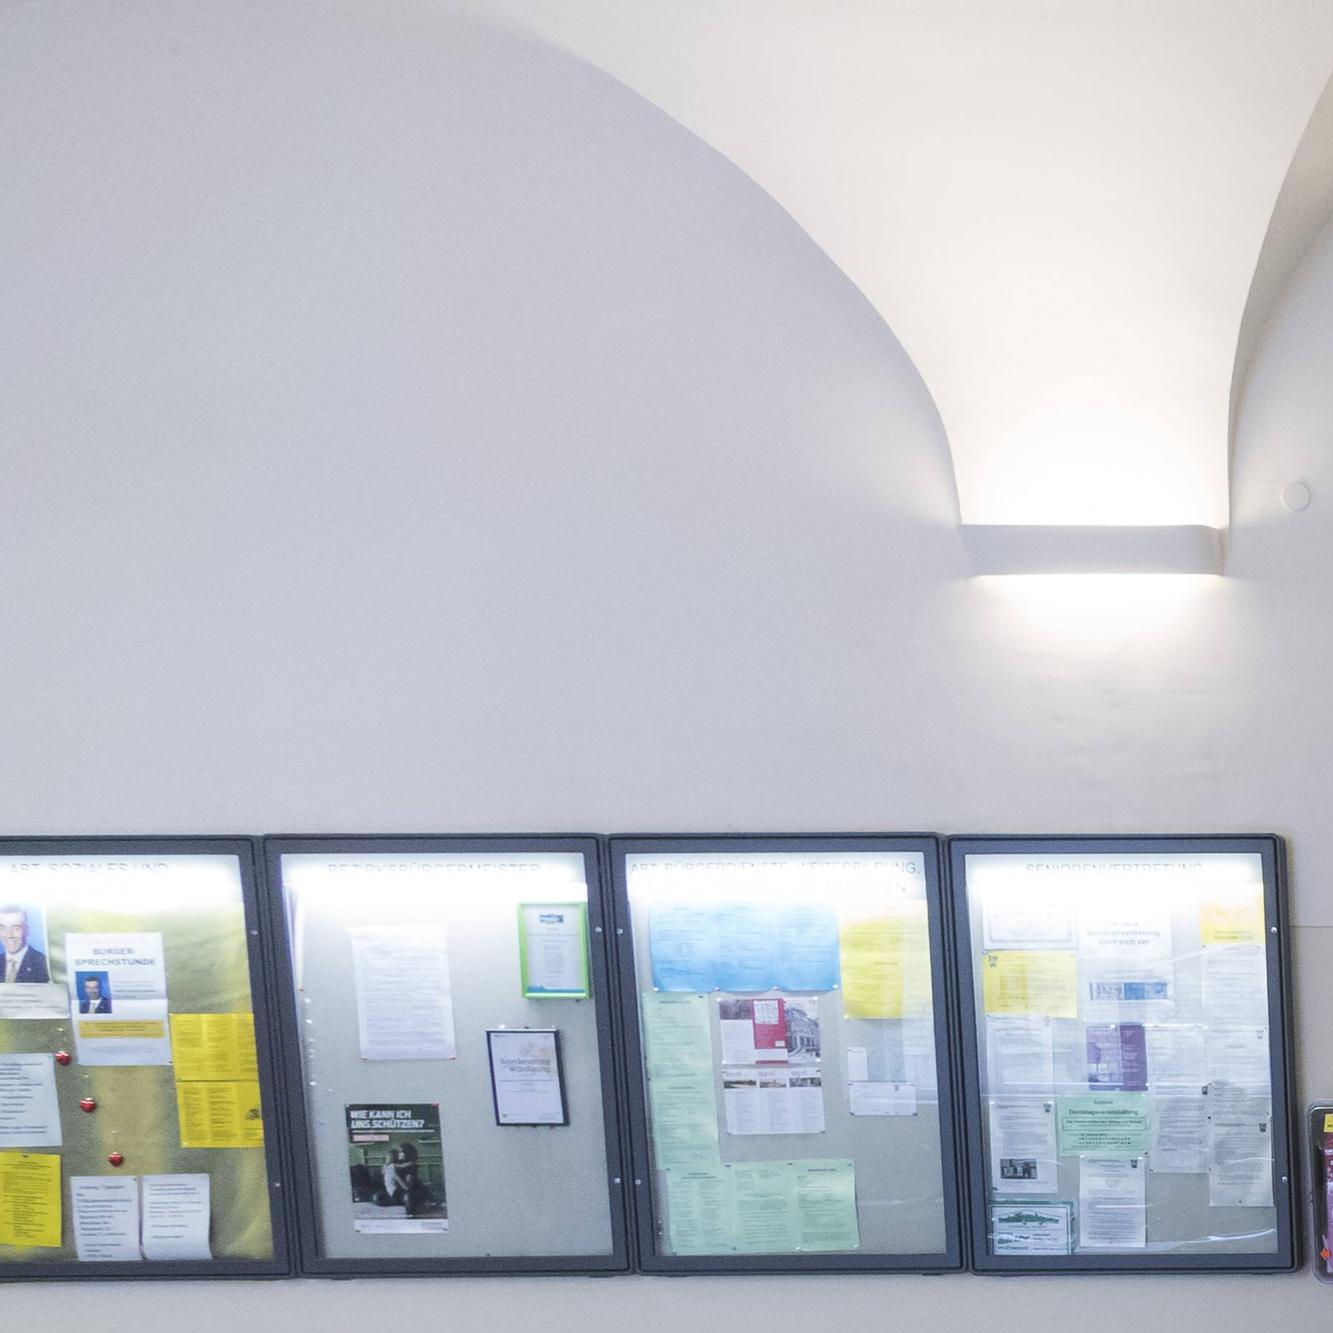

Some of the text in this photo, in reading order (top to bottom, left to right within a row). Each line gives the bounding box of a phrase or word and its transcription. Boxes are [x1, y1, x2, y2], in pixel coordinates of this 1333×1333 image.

[350, 1110, 412, 1119] WIE KANN ICH
[351, 1118, 425, 1129] UNS SCHÜTZEN?
